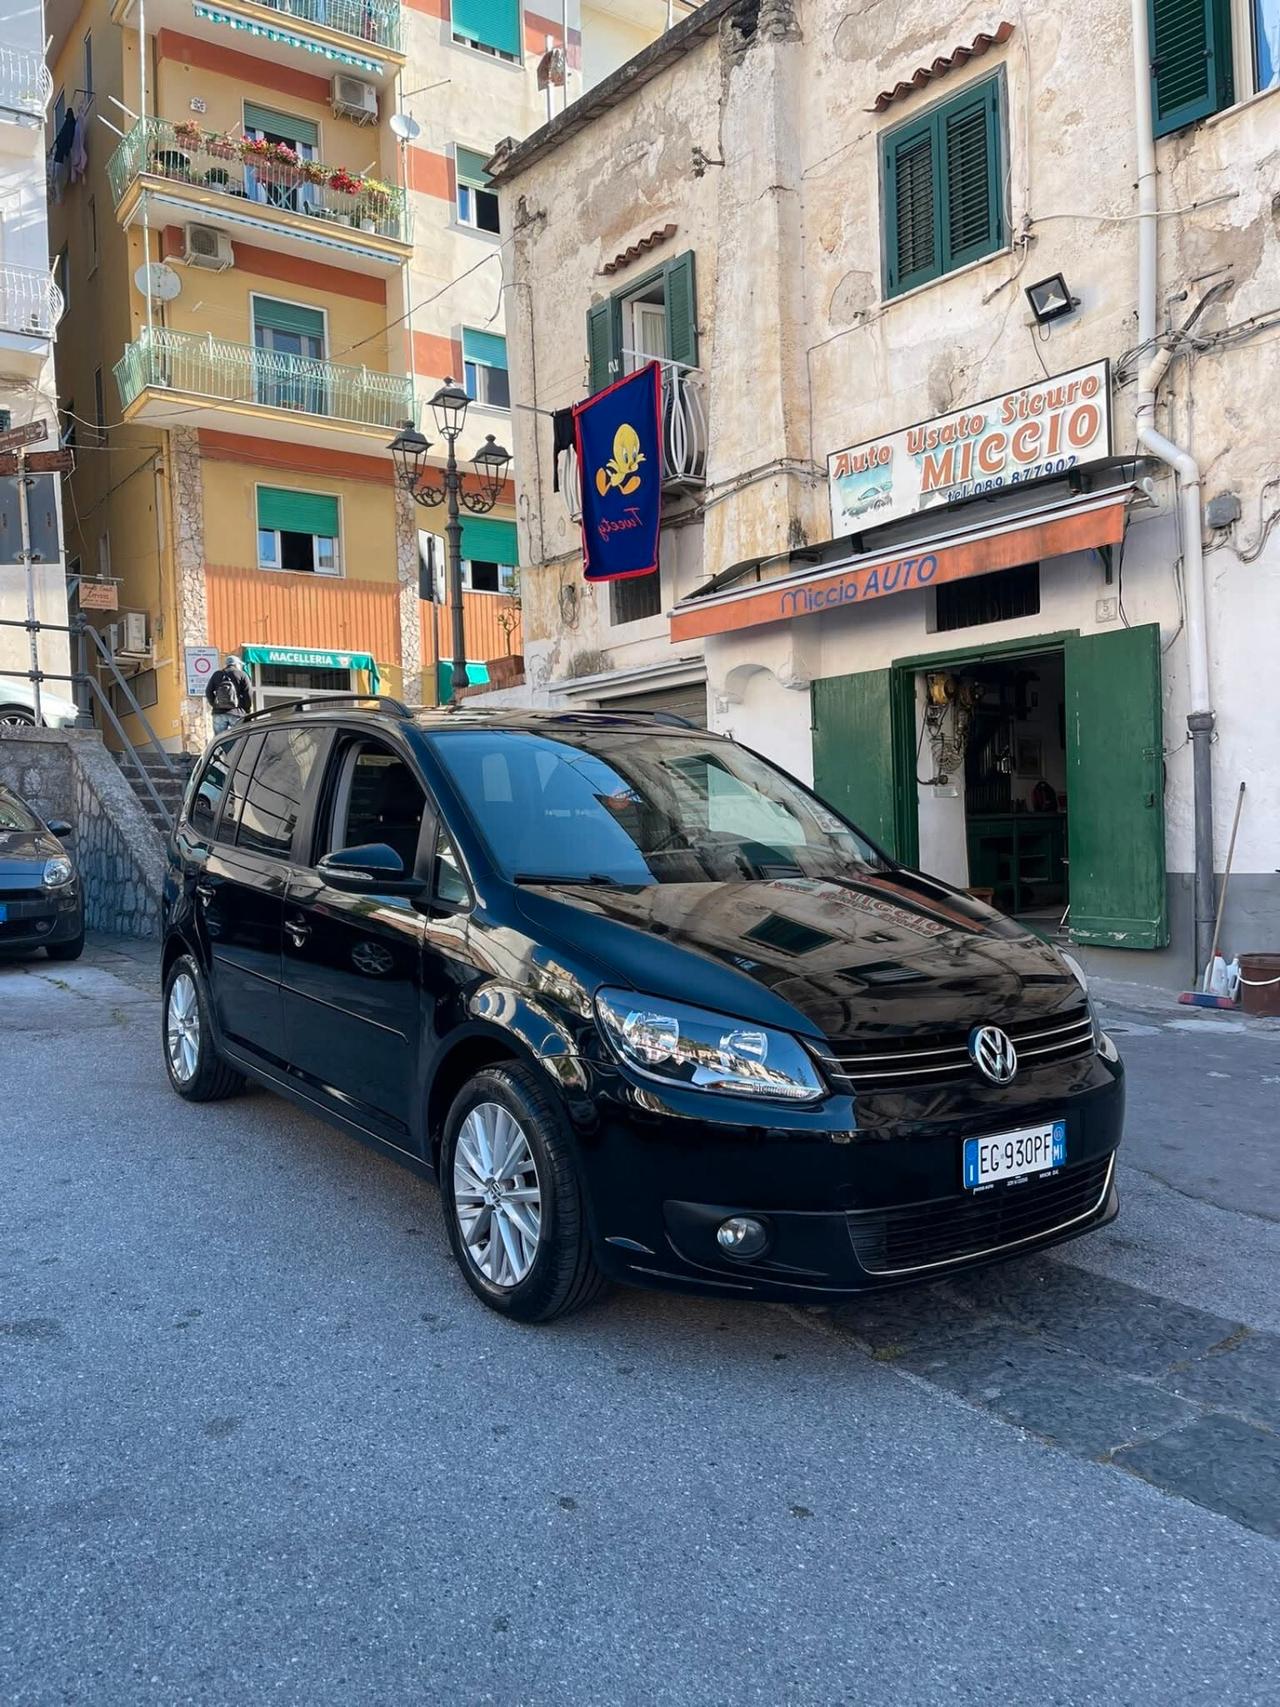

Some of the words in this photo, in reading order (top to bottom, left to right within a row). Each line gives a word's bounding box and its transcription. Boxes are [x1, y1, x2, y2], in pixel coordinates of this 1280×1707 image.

[833, 445, 893, 479] Auto
[906, 414, 985, 455] Usato
[1001, 374, 1099, 425] Sicuro
[921, 404, 1100, 493] MICCIO
[1011, 455, 1077, 483] 877902
[863, 555, 937, 596] AUTO
[269, 651, 333, 665] MACELLERIA
